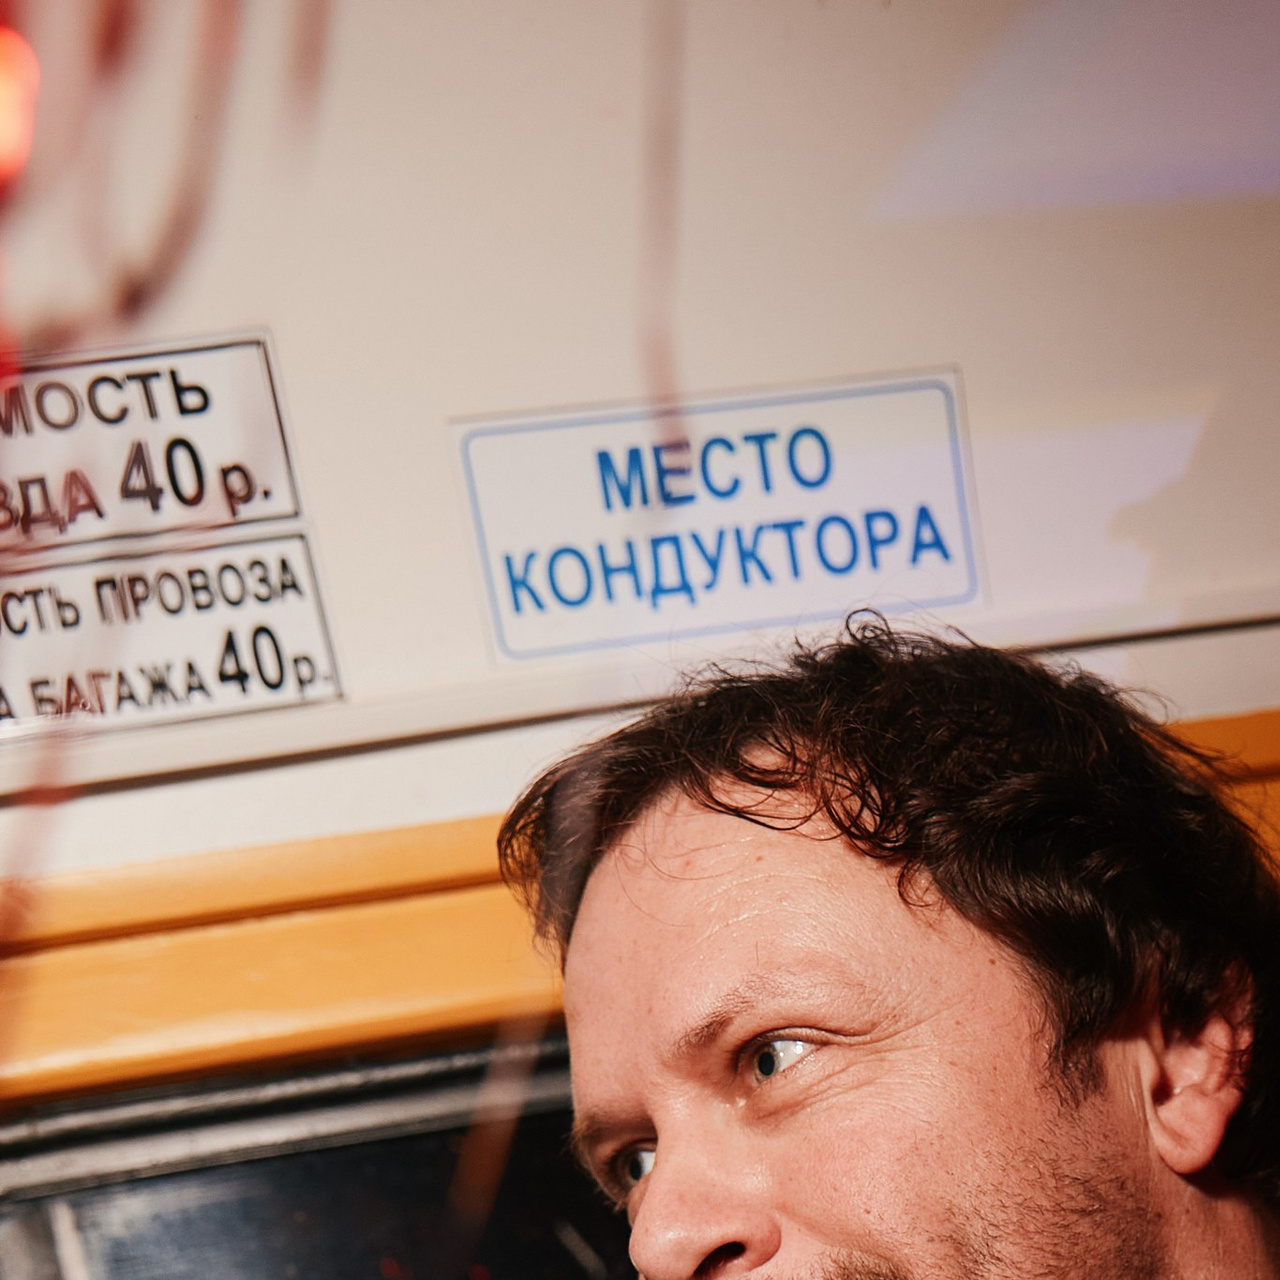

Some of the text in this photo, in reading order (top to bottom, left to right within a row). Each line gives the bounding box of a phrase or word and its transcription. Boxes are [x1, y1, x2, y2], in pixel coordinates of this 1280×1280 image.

[120, 437, 205, 513] 40
[596, 427, 833, 512] МЕСТО
[93, 557, 304, 624] ПРОВОЗА
[503, 505, 951, 615] КОНДУКТОРА
[30, 661, 210, 718] БАГАЖА
[218, 625, 285, 695] 40
